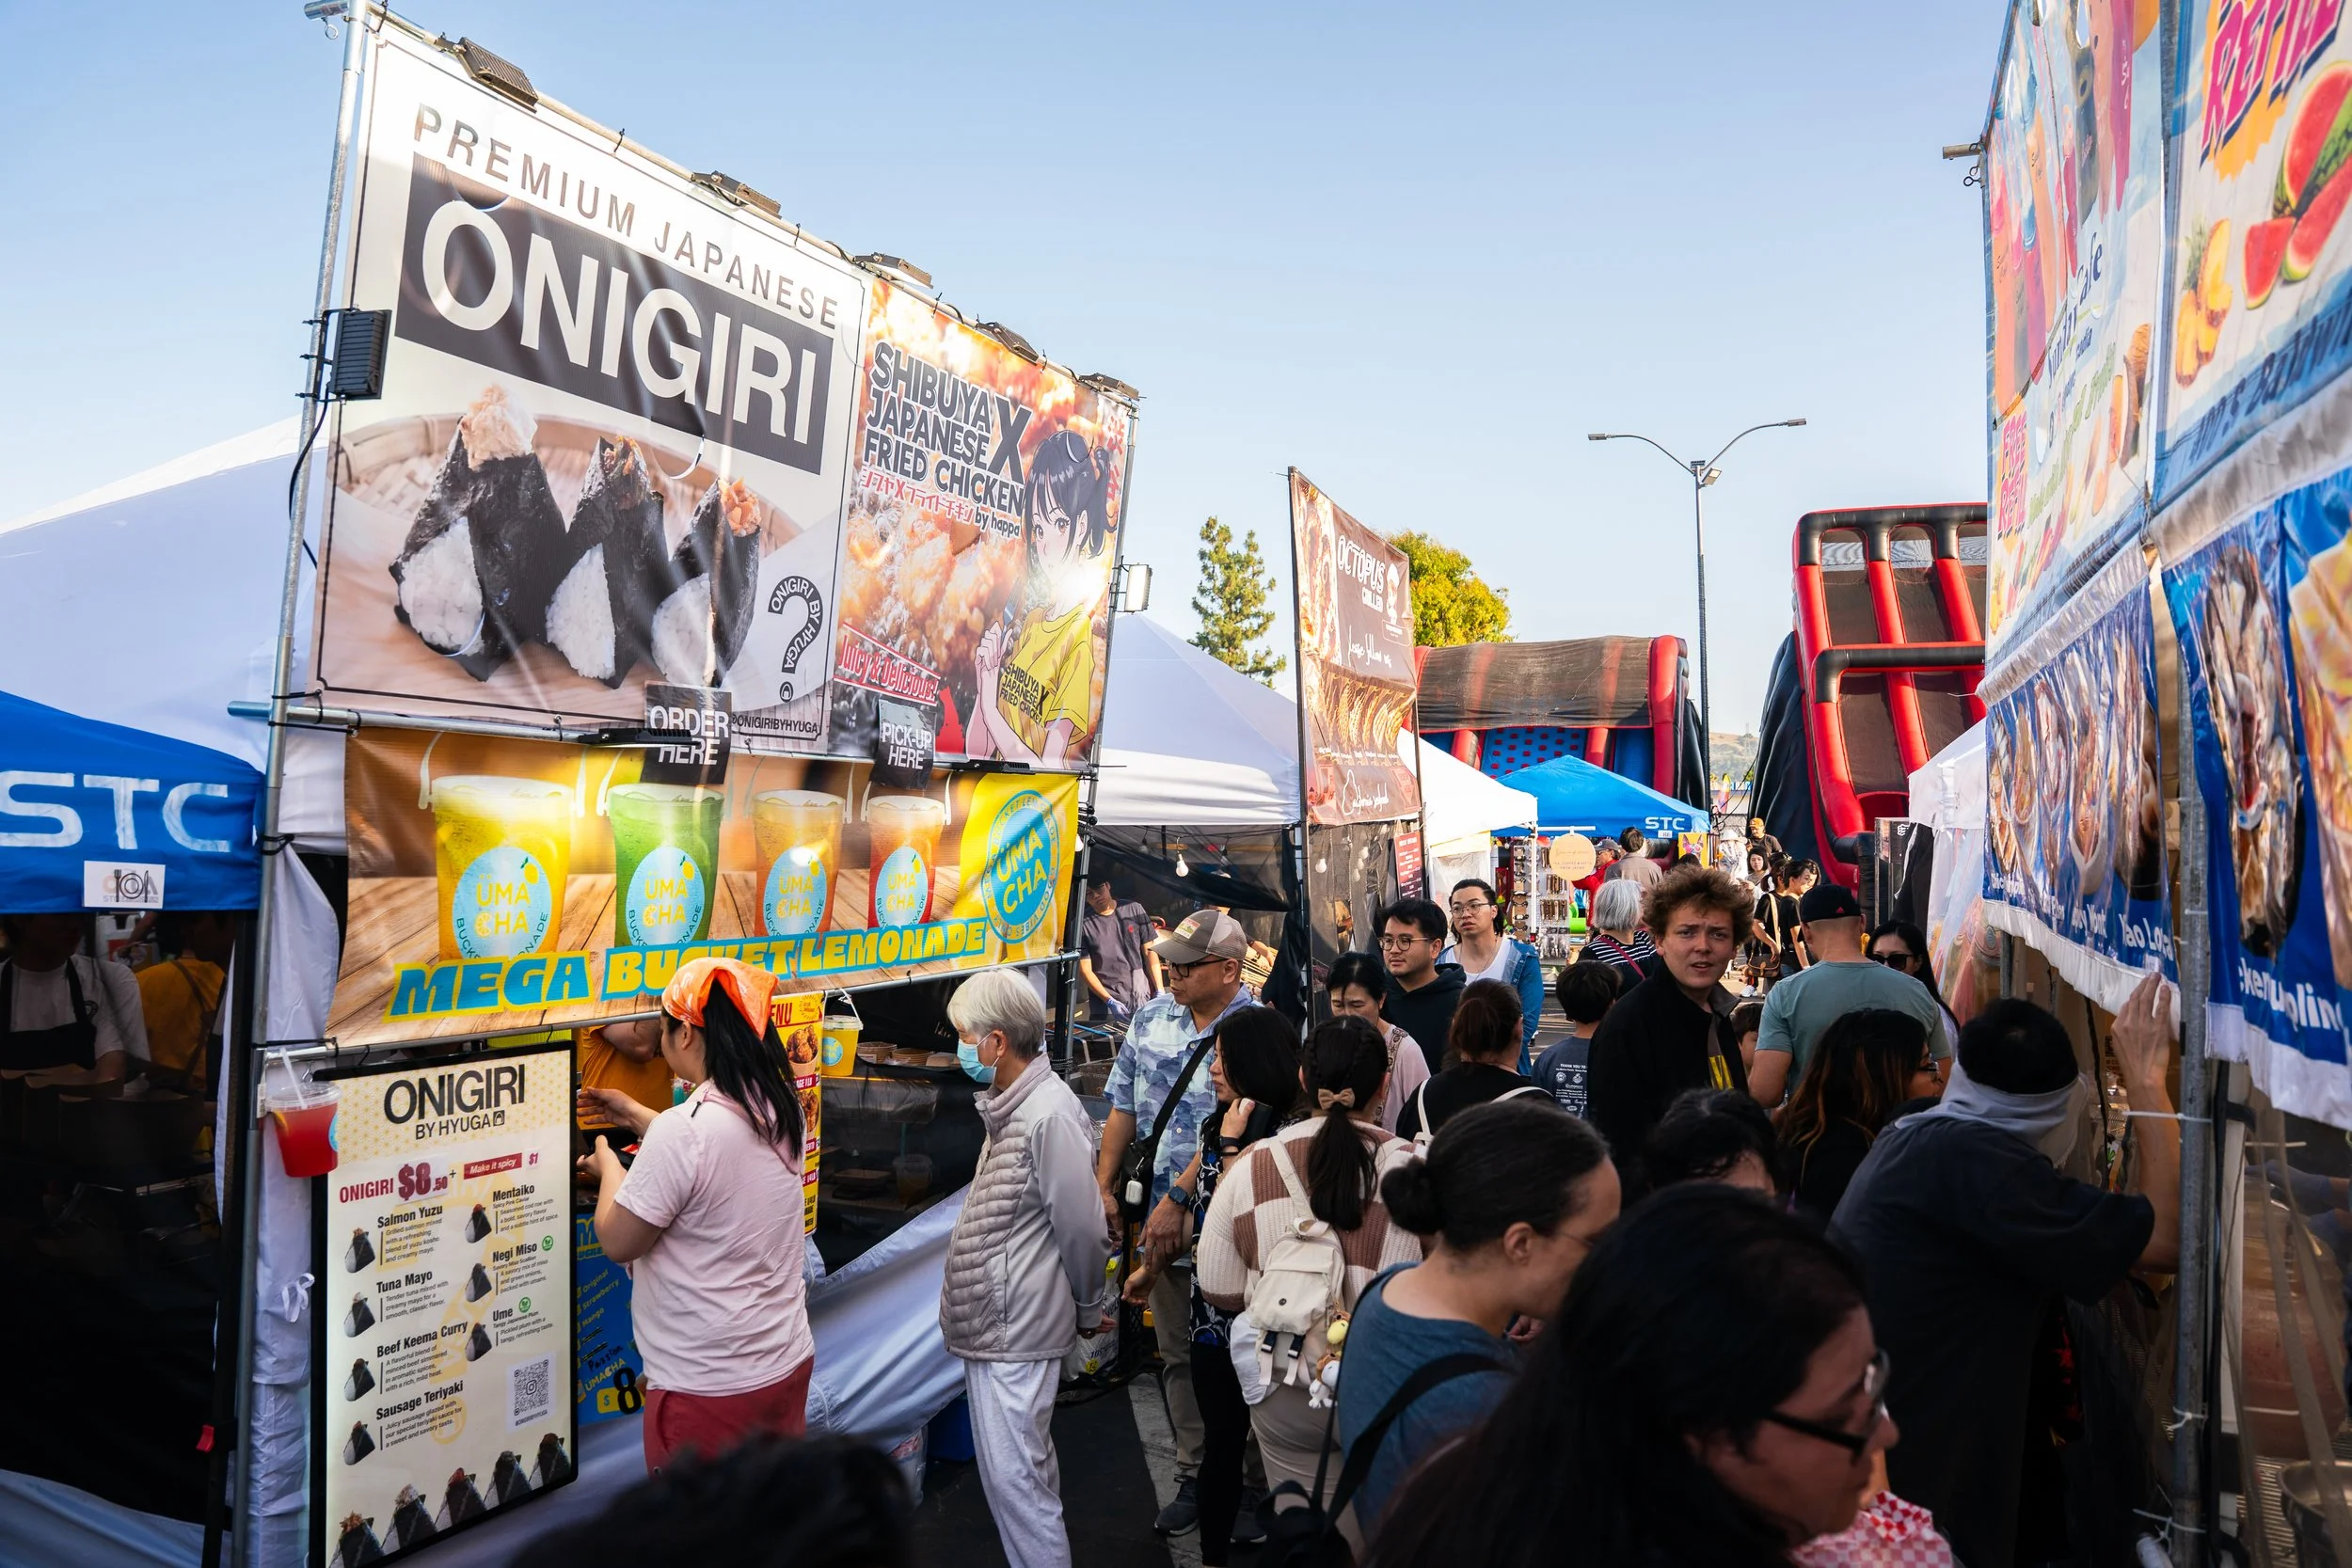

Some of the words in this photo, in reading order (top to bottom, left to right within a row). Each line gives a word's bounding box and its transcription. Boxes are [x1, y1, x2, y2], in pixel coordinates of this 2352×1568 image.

[413, 103, 636, 238] PREMIUM
[655, 221, 839, 330] JAPANESE
[869, 342, 992, 435] SHIBUYA
[988, 395, 1032, 484] X
[866, 388, 990, 470] JAPANESE
[864, 429, 928, 481] FRIED
[935, 459, 1025, 518] CHICKEN
[975, 506, 990, 530] by
[991, 512, 1021, 538] happa
[1338, 535, 1385, 594] OCTOPUS
[771, 578, 814, 611] ONIGIRI
[809, 599, 821, 624] BY
[784, 624, 817, 668] HYUGA
[838, 635, 871, 684] Juicy
[870, 653, 881, 684] &
[1000, 688, 1019, 706] FRIED
[1002, 675, 1038, 708] JAPANESE
[1005, 662, 1039, 696] SHIBUYA
[1036, 685, 1049, 716] X
[650, 705, 729, 738] ORDER
[882, 721, 932, 751] PICK-UP
[659, 737, 720, 765] HERE
[887, 744, 924, 769] HERE
[0, 770, 230, 852] STC
[1645, 816, 1685, 831] STC
[1003, 859, 1047, 914] CHA
[644, 904, 686, 927] CHA
[777, 898, 812, 919] CHA
[886, 895, 915, 911] CHA
[474, 911, 530, 938] CHA
[388, 952, 593, 1020] MEGA
[797, 922, 986, 973] LEMONADE
[770, 1003, 793, 1026] ENU
[384, 1064, 525, 1124] ONIGIRI
[416, 1122, 436, 1140] BY
[438, 1115, 491, 1136] HYUGA
[340, 1178, 393, 1203] ONIGIRI
[470, 1164, 489, 1175] Make
[490, 1163, 498, 1171] it
[498, 1159, 516, 1171] spicy
[493, 1184, 534, 1202] Mentaiko
[377, 1212, 416, 1228] Salmon
[419, 1206, 443, 1218] Yuzu
[386, 1227, 404, 1236] Grilled
[397, 1251, 418, 1261] creamy
[493, 1247, 513, 1262] Negi
[516, 1243, 537, 1256] Miso
[376, 1279, 402, 1293] Tuna
[405, 1271, 433, 1286] Mayo
[583, 1269, 608, 1292] Original
[386, 1292, 405, 1302] Tender
[386, 1301, 407, 1311] creamy
[583, 1279, 618, 1309] Strawberry
[409, 1304, 428, 1314] classic
[493, 1308, 513, 1322] Ume
[582, 1307, 604, 1327] Mango
[377, 1339, 401, 1358] Beef
[404, 1331, 437, 1350] Keema
[440, 1322, 469, 1338] Curry
[386, 1364, 406, 1374] minced
[406, 1358, 420, 1368] beef
[391, 1352, 414, 1365] flavorful
[415, 1348, 431, 1356] blend
[386, 1384, 398, 1392] with
[391, 1370, 416, 1382] aromatic
[376, 1397, 421, 1420] Sausage
[424, 1380, 463, 1403] Teriyaki
[603, 1395, 611, 1406] $
[613, 1367, 643, 1415] 8
[386, 1420, 402, 1430] Juicy
[402, 1412, 425, 1424] sausage
[396, 1424, 416, 1435] special
[417, 1415, 437, 1428] teriyaki
